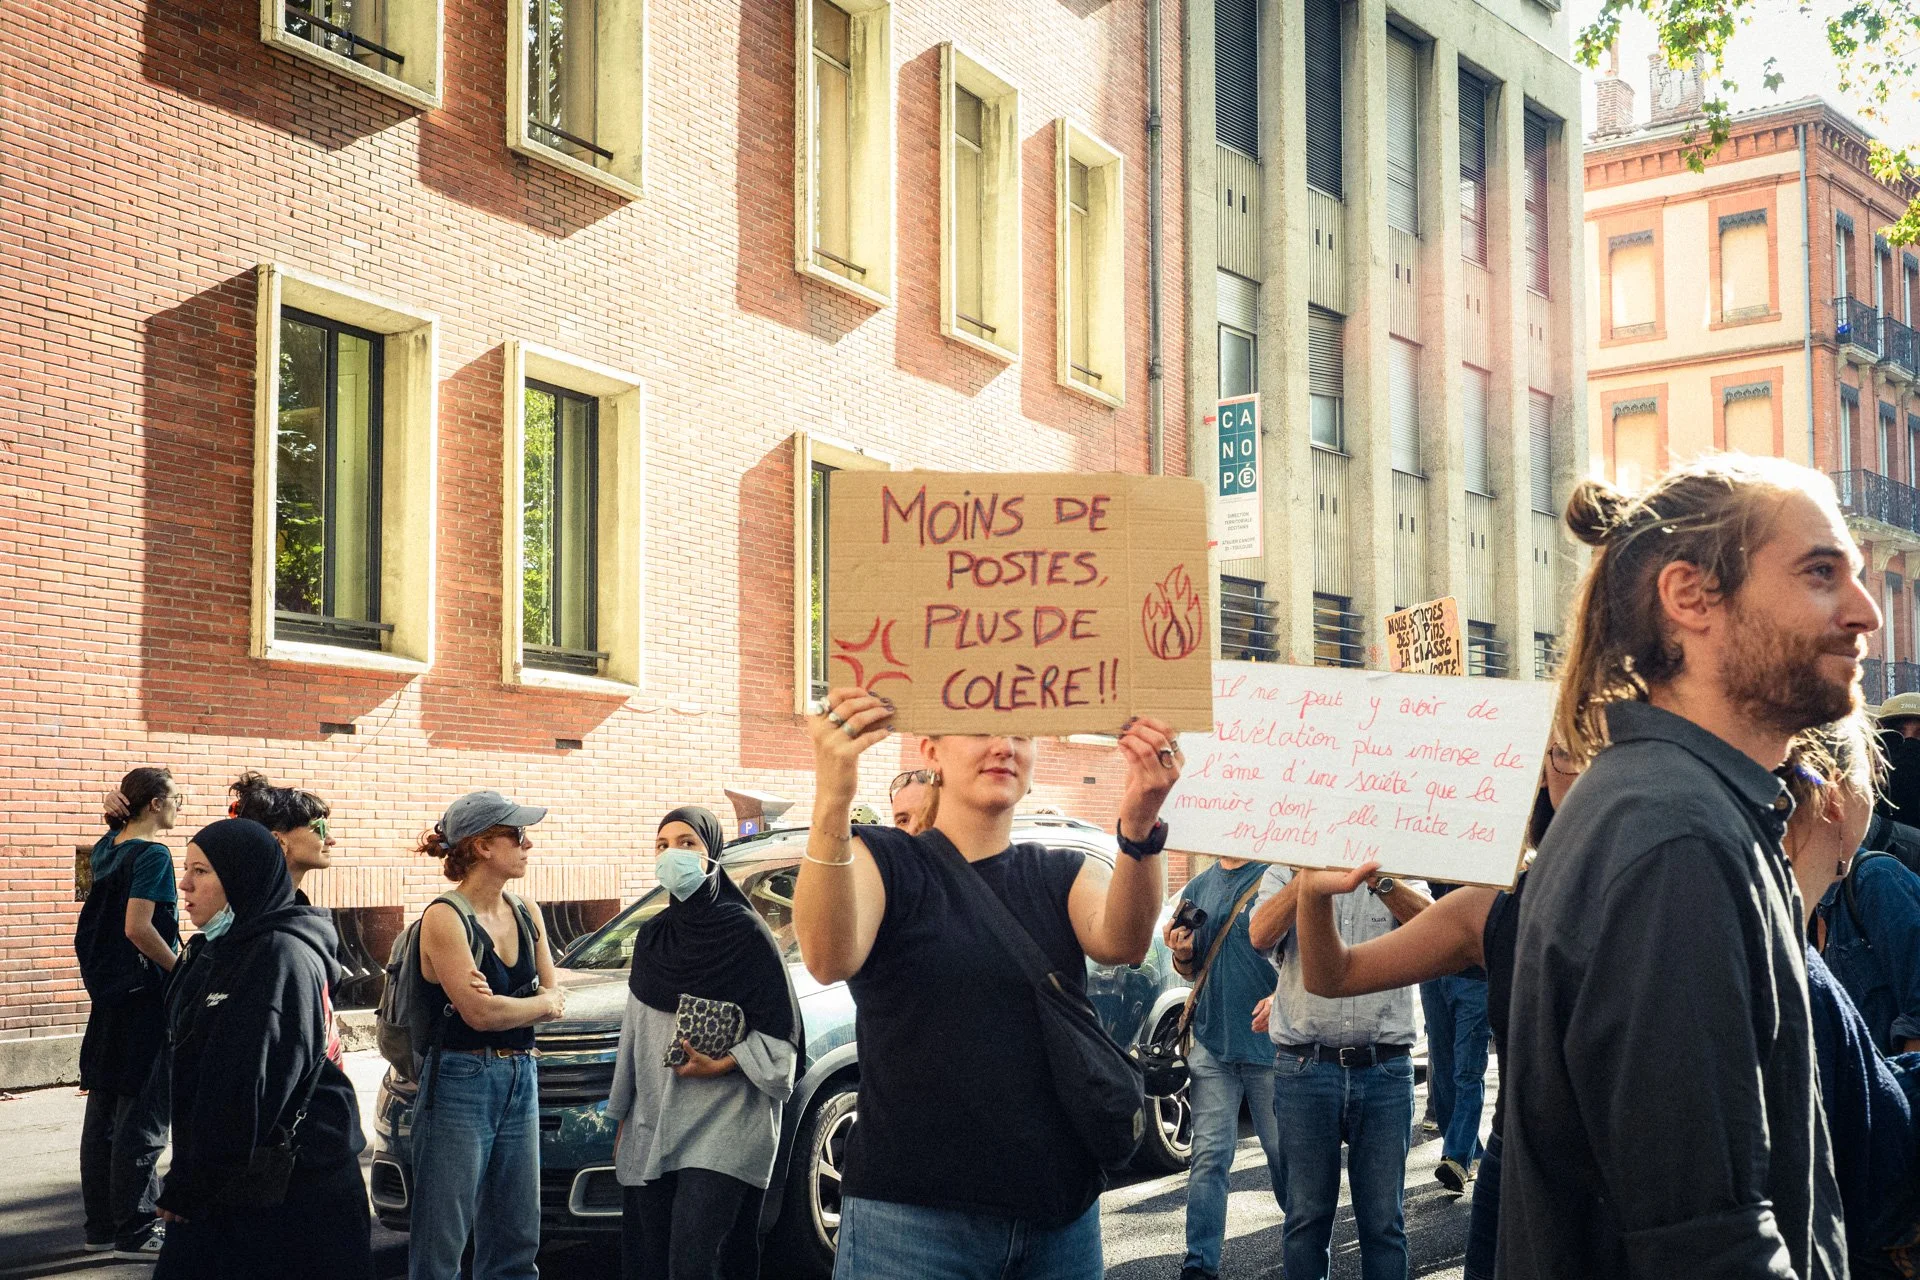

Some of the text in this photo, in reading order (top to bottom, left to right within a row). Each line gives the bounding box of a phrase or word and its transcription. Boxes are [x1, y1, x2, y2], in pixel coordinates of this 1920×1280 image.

[1055, 495, 1111, 531] DE
[946, 549, 1109, 591] POSTES,
[924, 604, 1100, 650] PLUS DE
[1387, 614, 1408, 635] NOUS
[941, 657, 1120, 712] COLÈRE!!
[1213, 675, 1247, 698] Il
[1249, 686, 1279, 700] ne
[1358, 696, 1381, 731] y
[1400, 695, 1447, 717] avoir
[1467, 699, 1500, 721] de
[1208, 718, 1525, 769] révélation plus intense de
[1188, 752, 1264, 781] l'âme
[1345, 770, 1418, 795] société
[1426, 781, 1457, 813] que
[1465, 776, 1499, 803] la
[745, 821, 753, 834] P
[1175, 791, 1496, 843] manière dont elle traite ses
